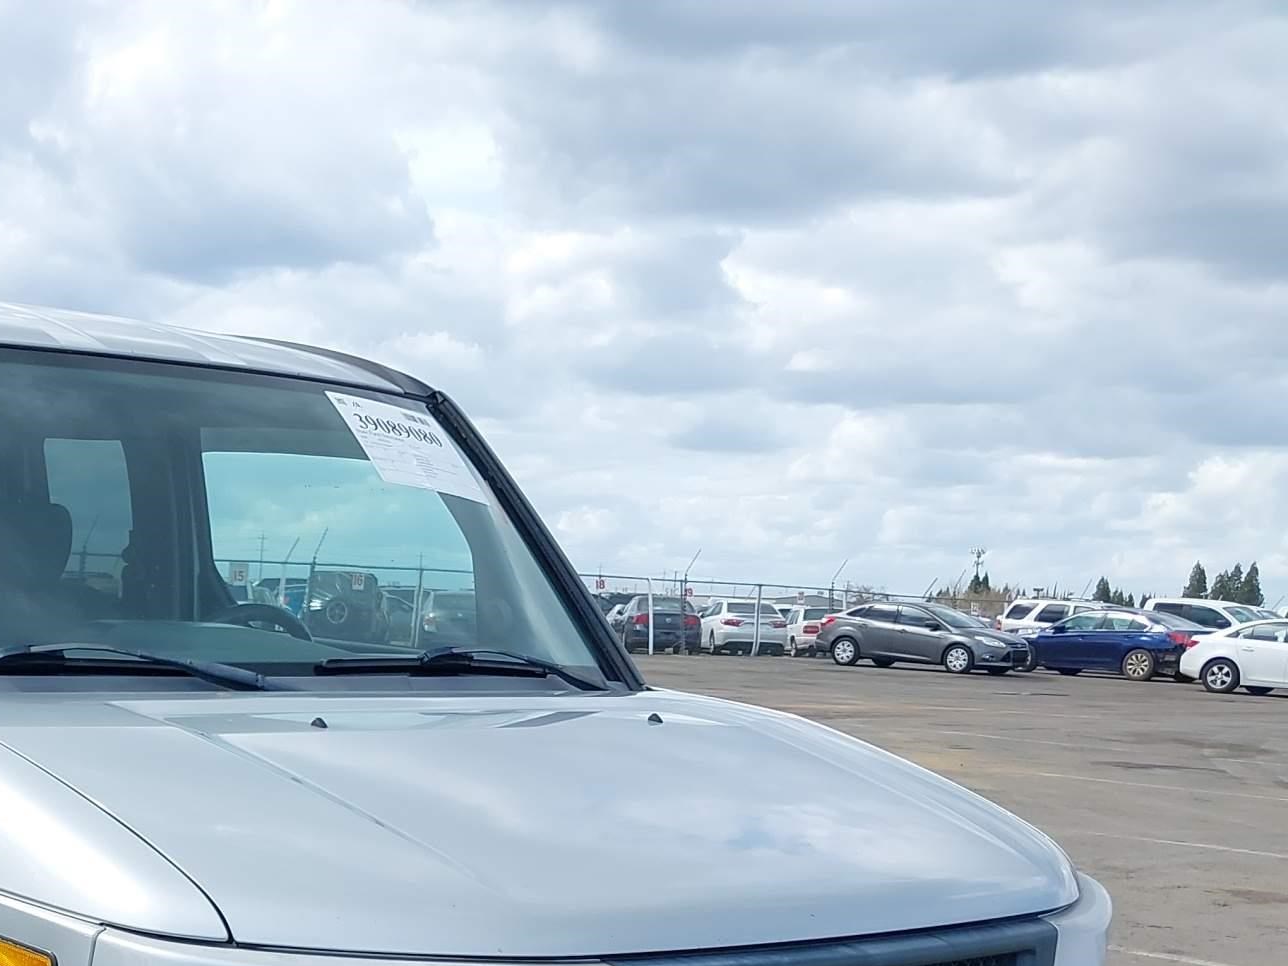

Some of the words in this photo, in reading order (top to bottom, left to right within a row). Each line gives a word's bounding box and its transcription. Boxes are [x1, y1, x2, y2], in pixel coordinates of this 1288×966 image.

[353, 413, 443, 448] 39089080
[233, 570, 245, 581] 15
[595, 580, 605, 589] 18
